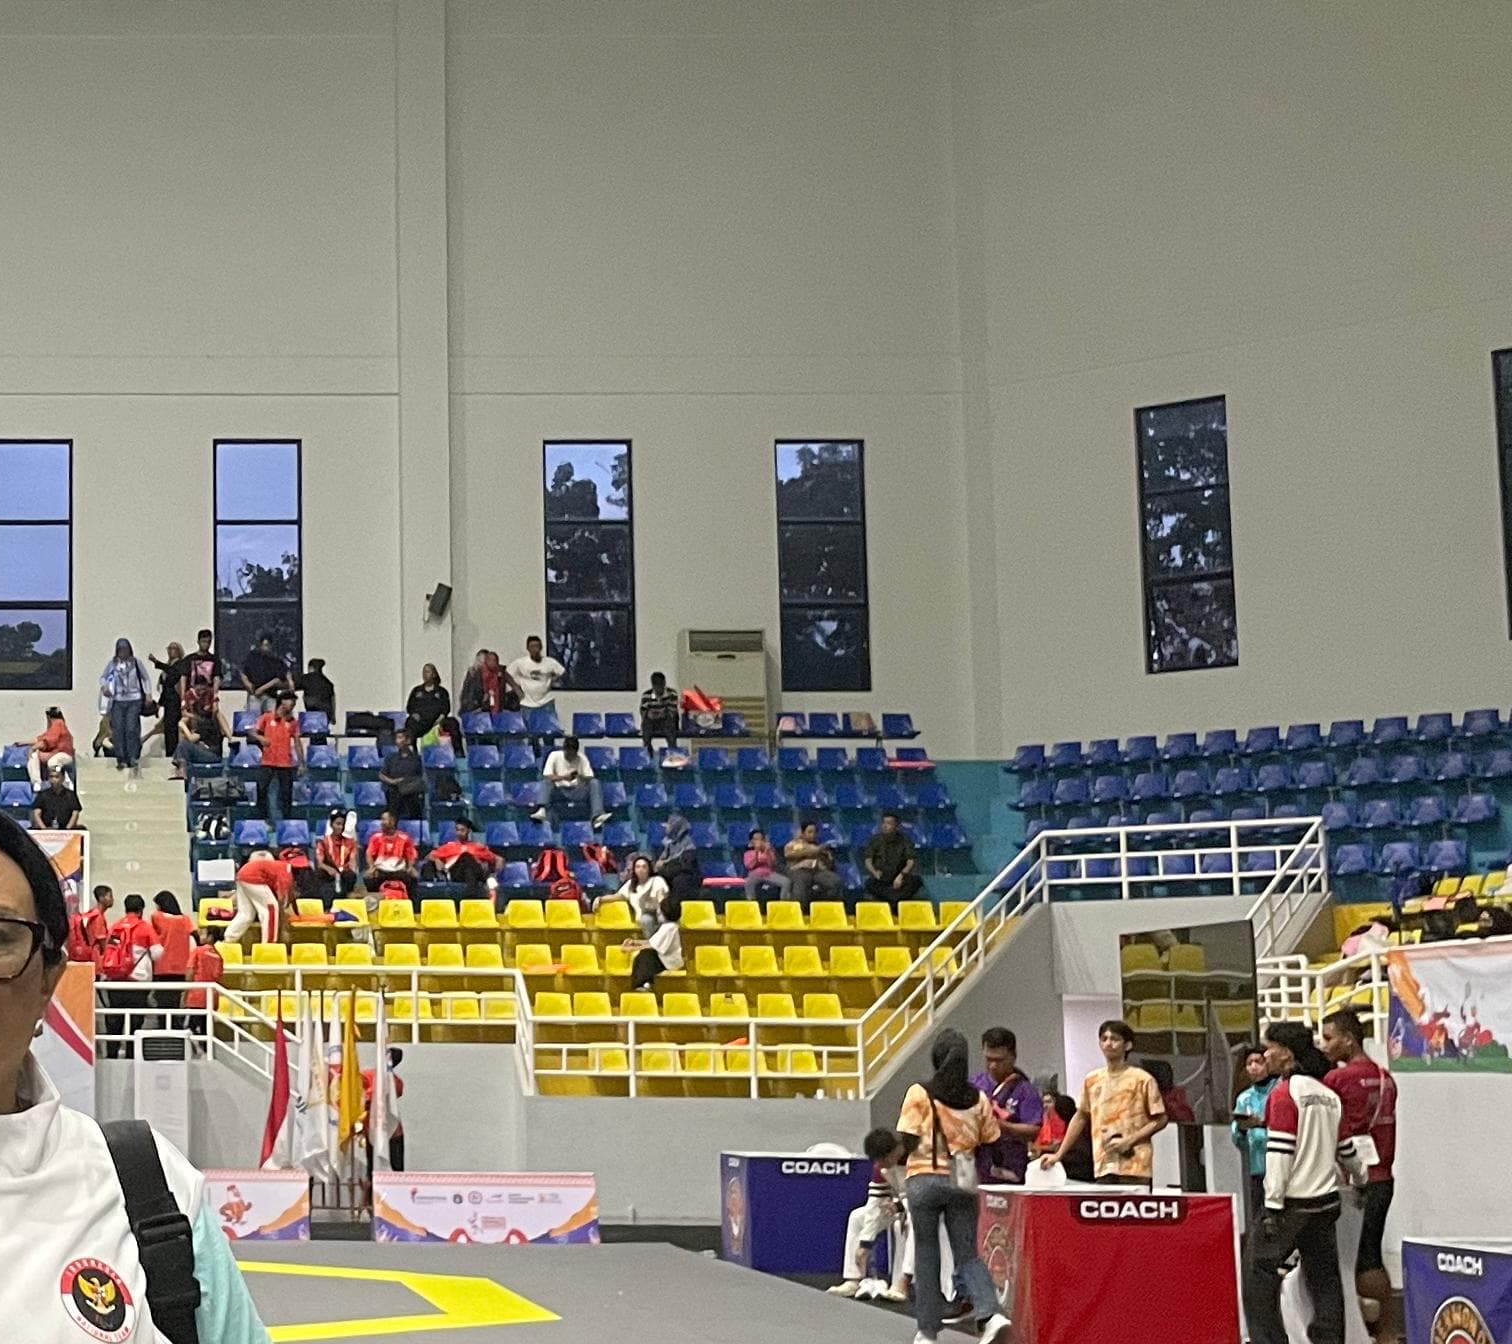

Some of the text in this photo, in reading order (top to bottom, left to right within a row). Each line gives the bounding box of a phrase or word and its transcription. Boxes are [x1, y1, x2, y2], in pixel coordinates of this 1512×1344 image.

[781, 1161, 849, 1174] COACH
[1080, 1200, 1178, 1218] COACH
[1437, 1253, 1483, 1276] COACH
